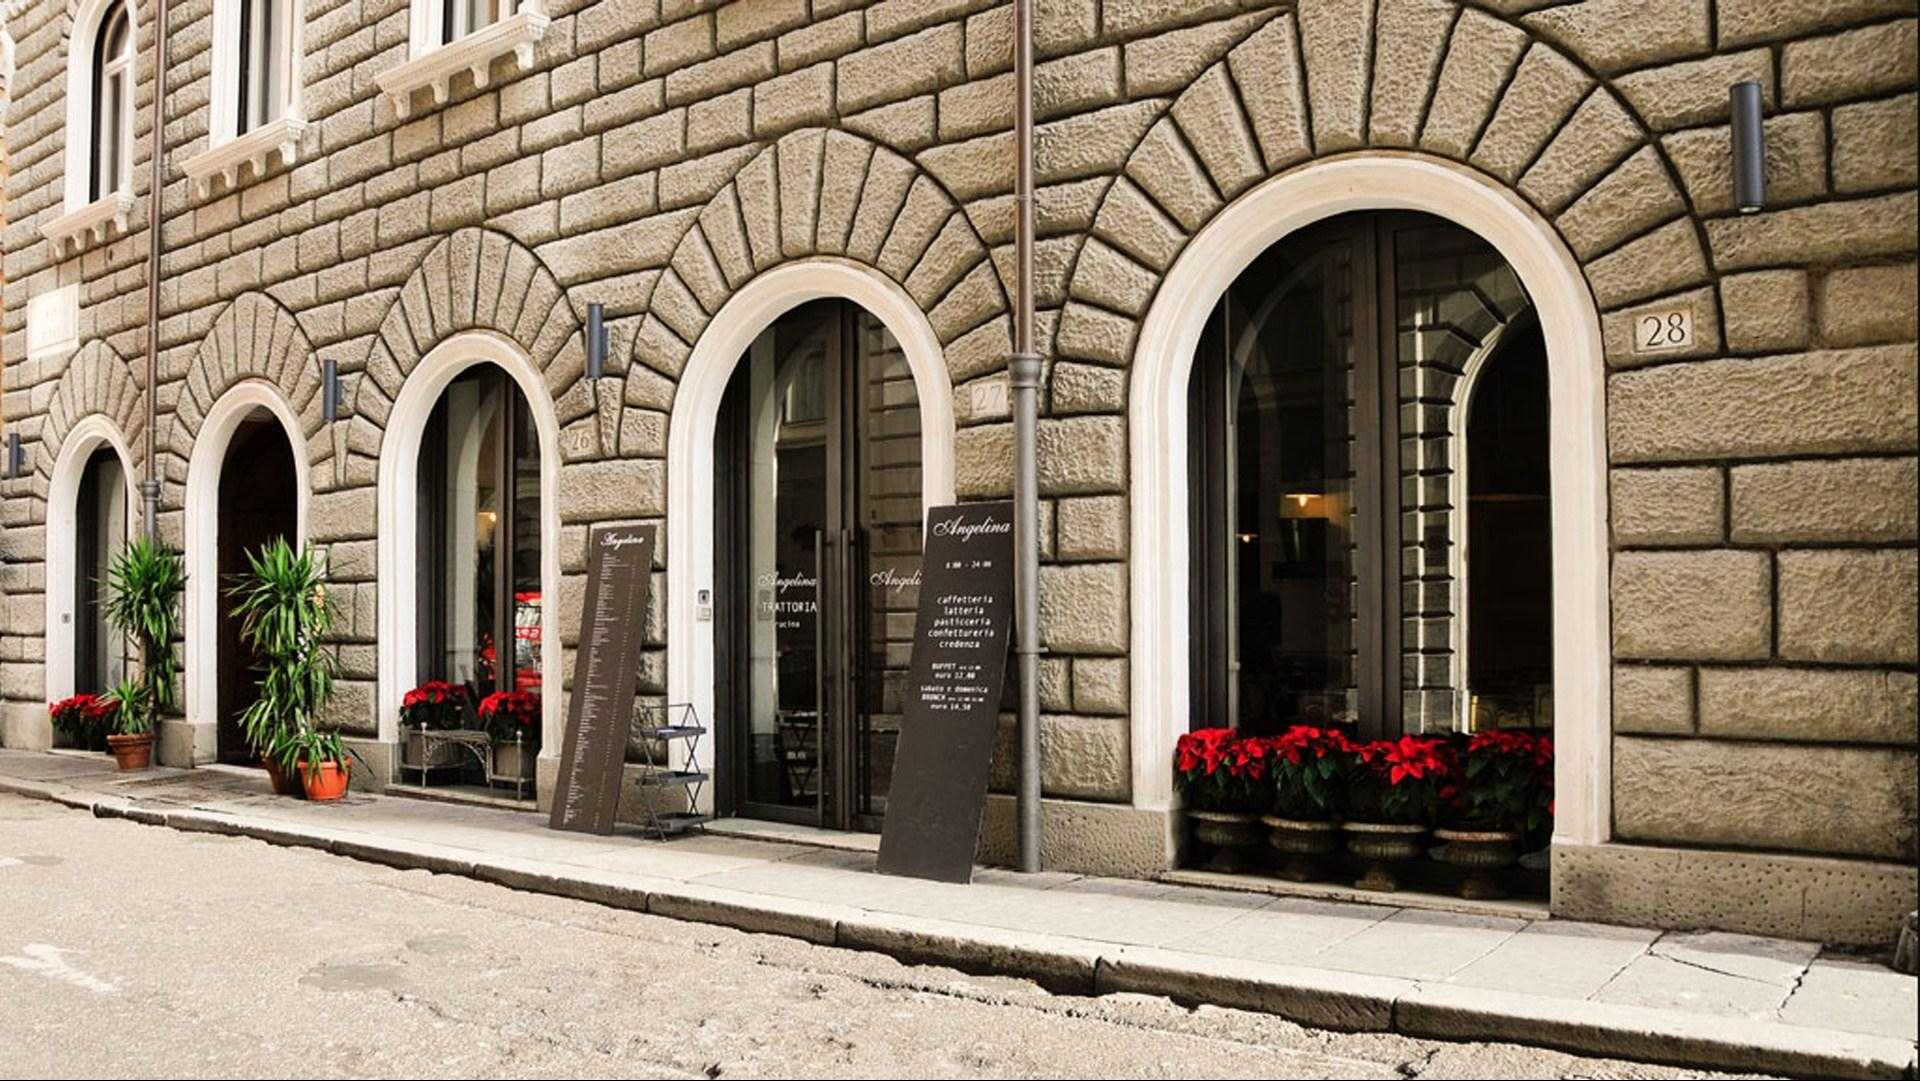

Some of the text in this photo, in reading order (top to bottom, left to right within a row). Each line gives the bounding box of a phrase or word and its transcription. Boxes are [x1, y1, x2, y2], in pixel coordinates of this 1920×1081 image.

[1643, 312, 1685, 346] 28
[974, 384, 1004, 411] 27
[932, 515, 1011, 542] Angelina
[757, 570, 818, 595] Angelina
[870, 567, 922, 594] Angeli
[936, 594, 994, 605] caffetteria
[763, 601, 818, 613] TRATTORIA
[944, 605, 985, 616] latteria
[933, 617, 992, 628] pasticceria
[927, 628, 995, 639] confettureria
[939, 640, 981, 649] credenza
